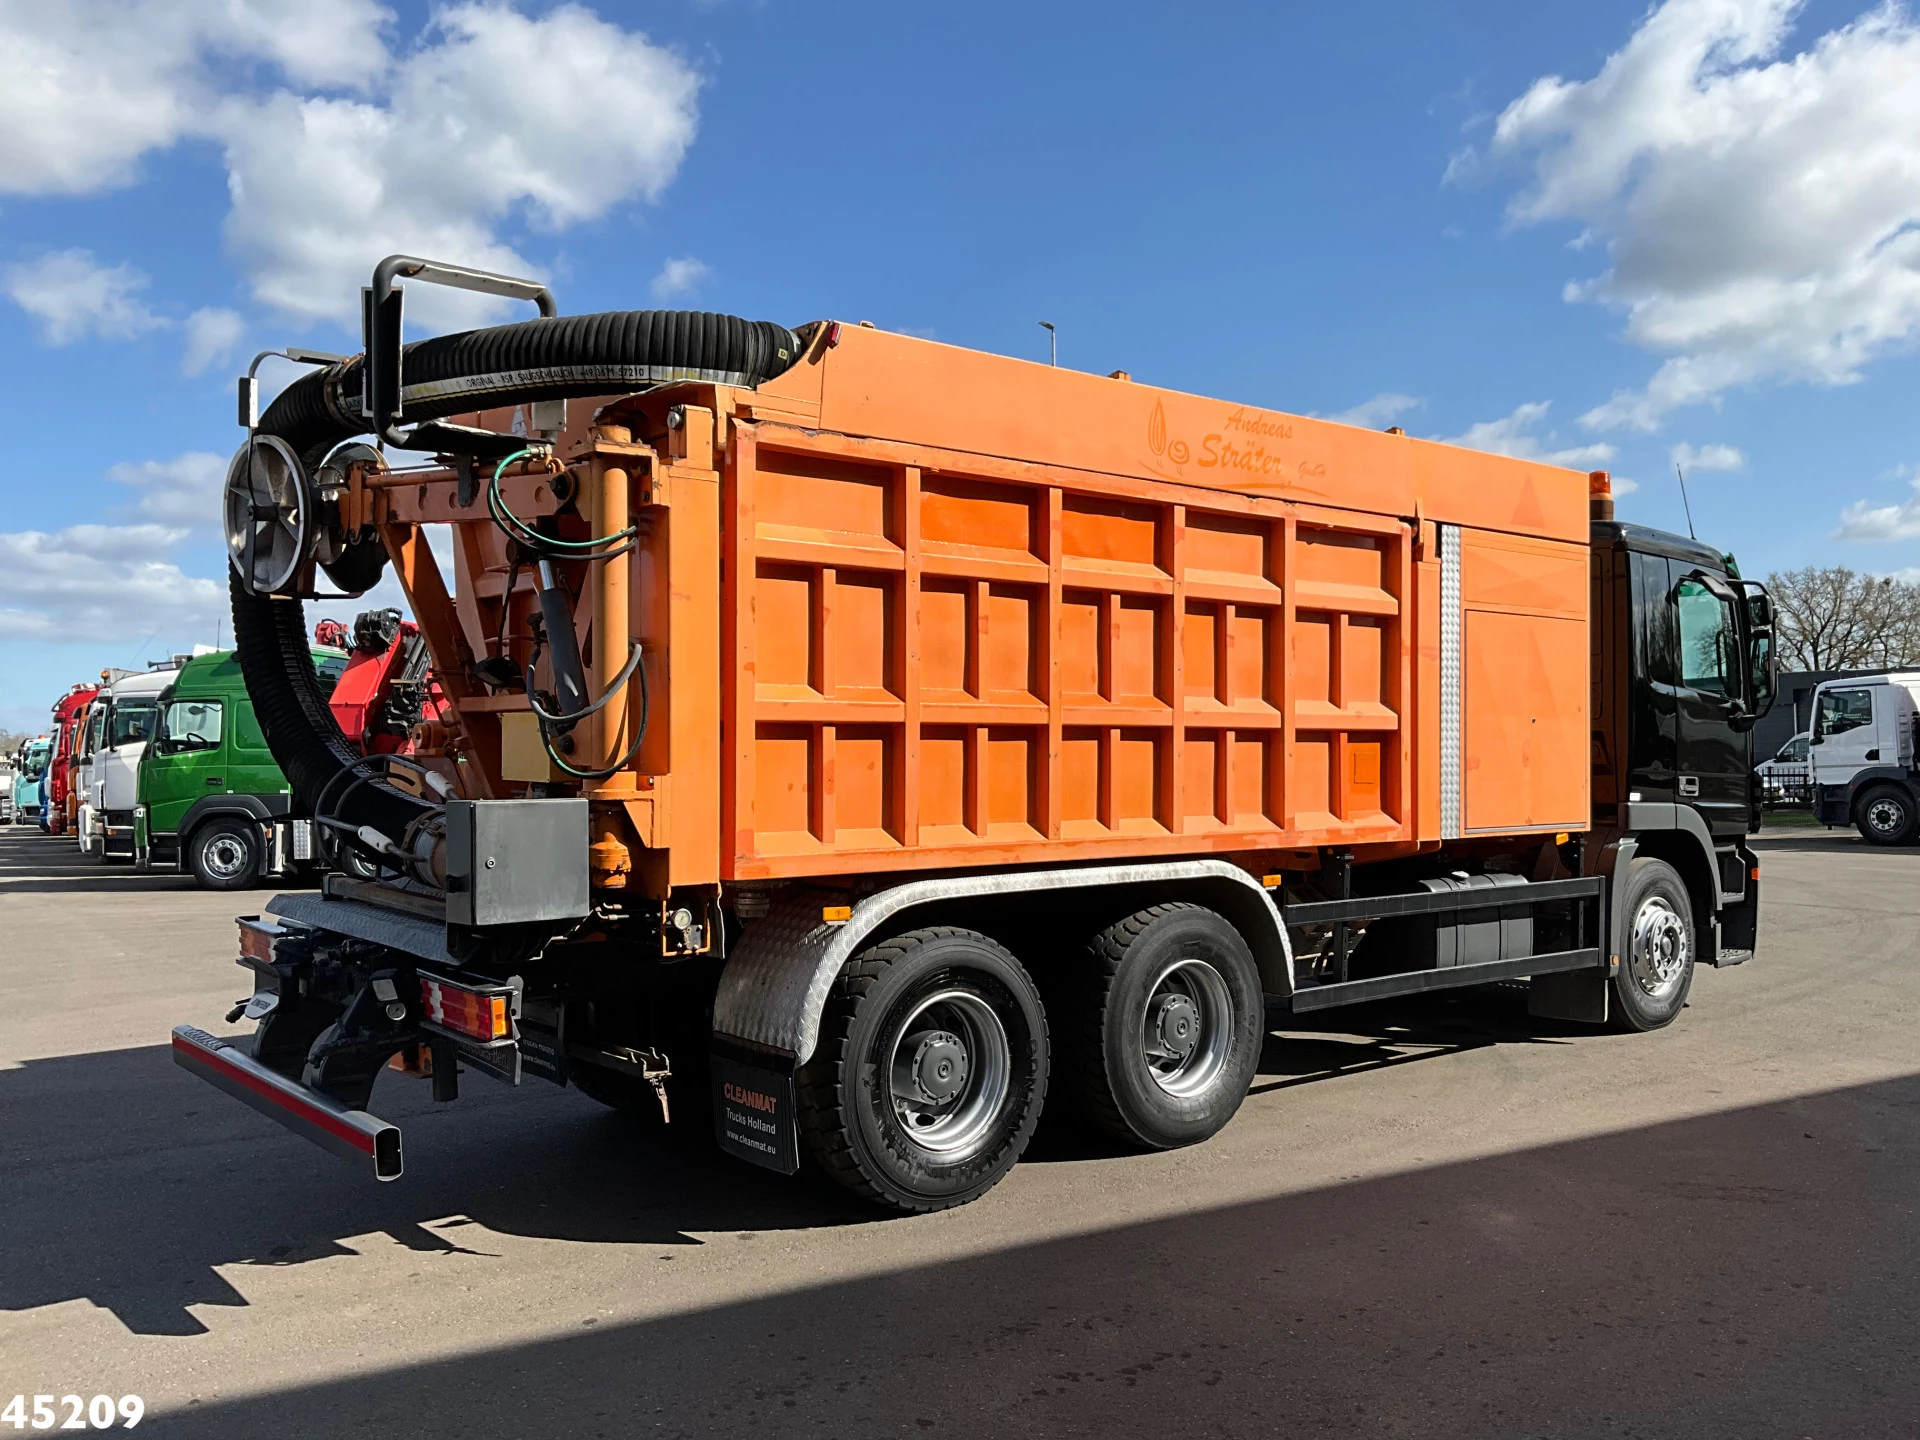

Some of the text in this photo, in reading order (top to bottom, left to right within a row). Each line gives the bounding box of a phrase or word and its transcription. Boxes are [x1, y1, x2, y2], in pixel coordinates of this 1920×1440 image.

[619, 367, 645, 377] 57210
[1224, 407, 1293, 439] Andreas
[1197, 434, 1281, 474] Sträter
[724, 1082, 777, 1114] CLEANMAT
[726, 1107, 776, 1135] Trucks Holland
[726, 1130, 776, 1154] www.cleanmat.eu
